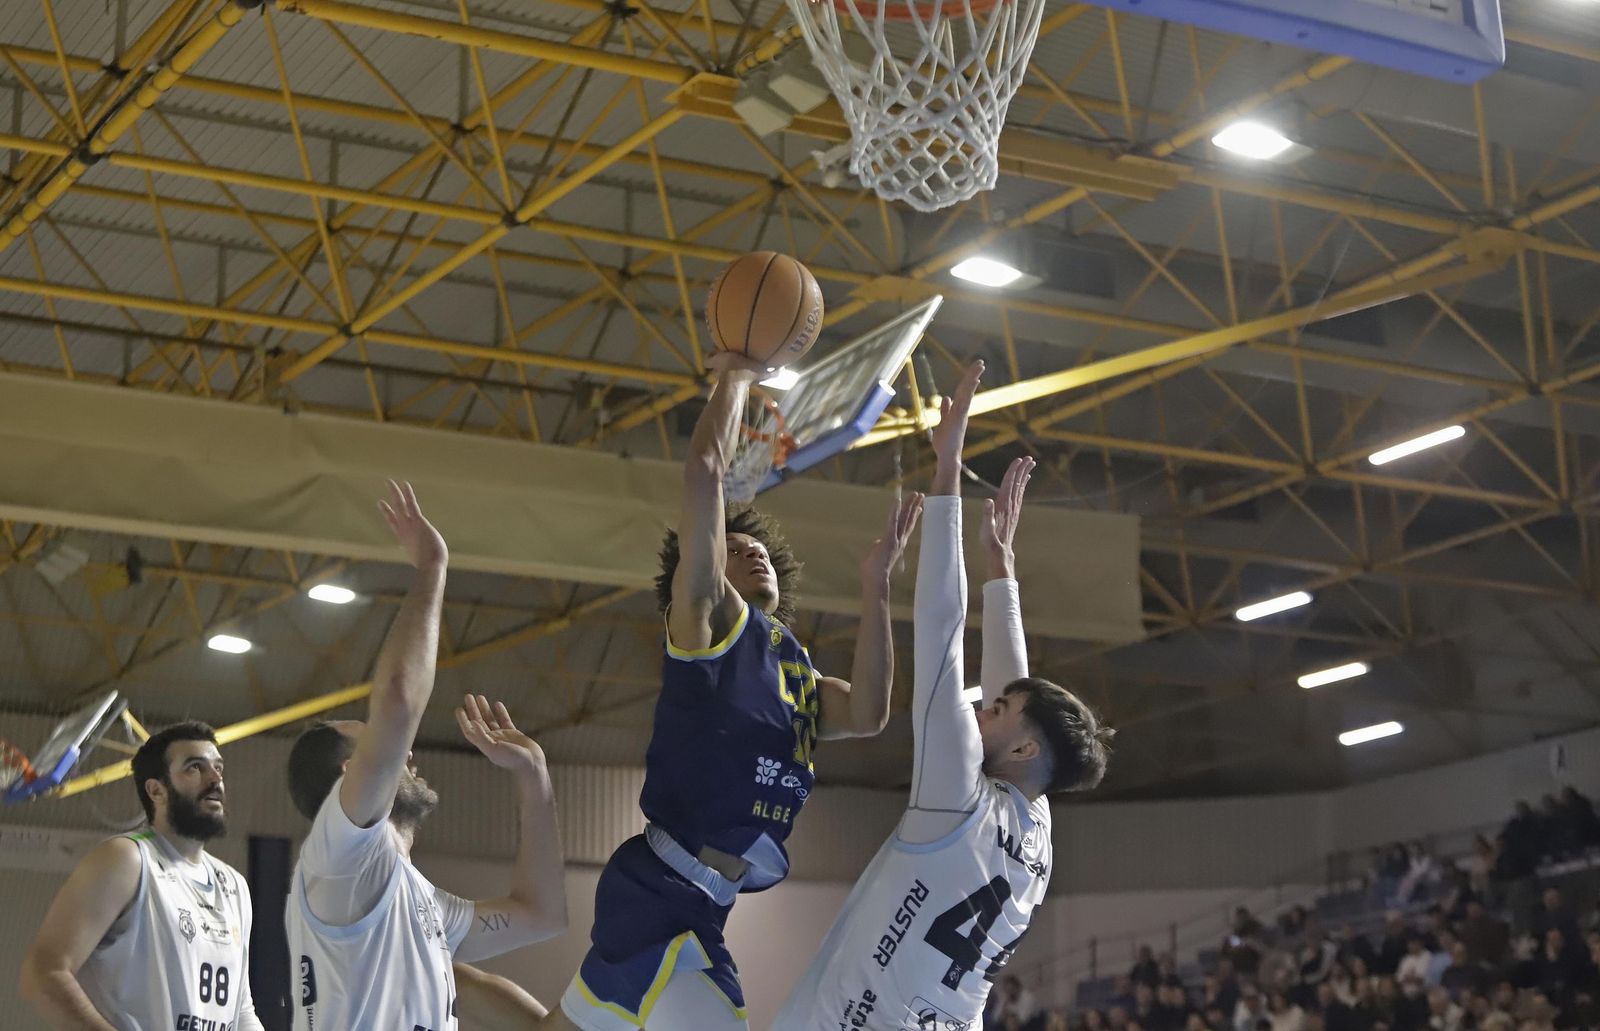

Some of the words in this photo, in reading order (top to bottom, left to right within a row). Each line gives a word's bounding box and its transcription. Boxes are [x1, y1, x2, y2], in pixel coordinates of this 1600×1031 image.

[479, 912, 512, 933] XIV
[873, 879, 930, 967] RUSTER
[199, 962, 229, 1006] 88
[851, 989, 877, 1031] atra
